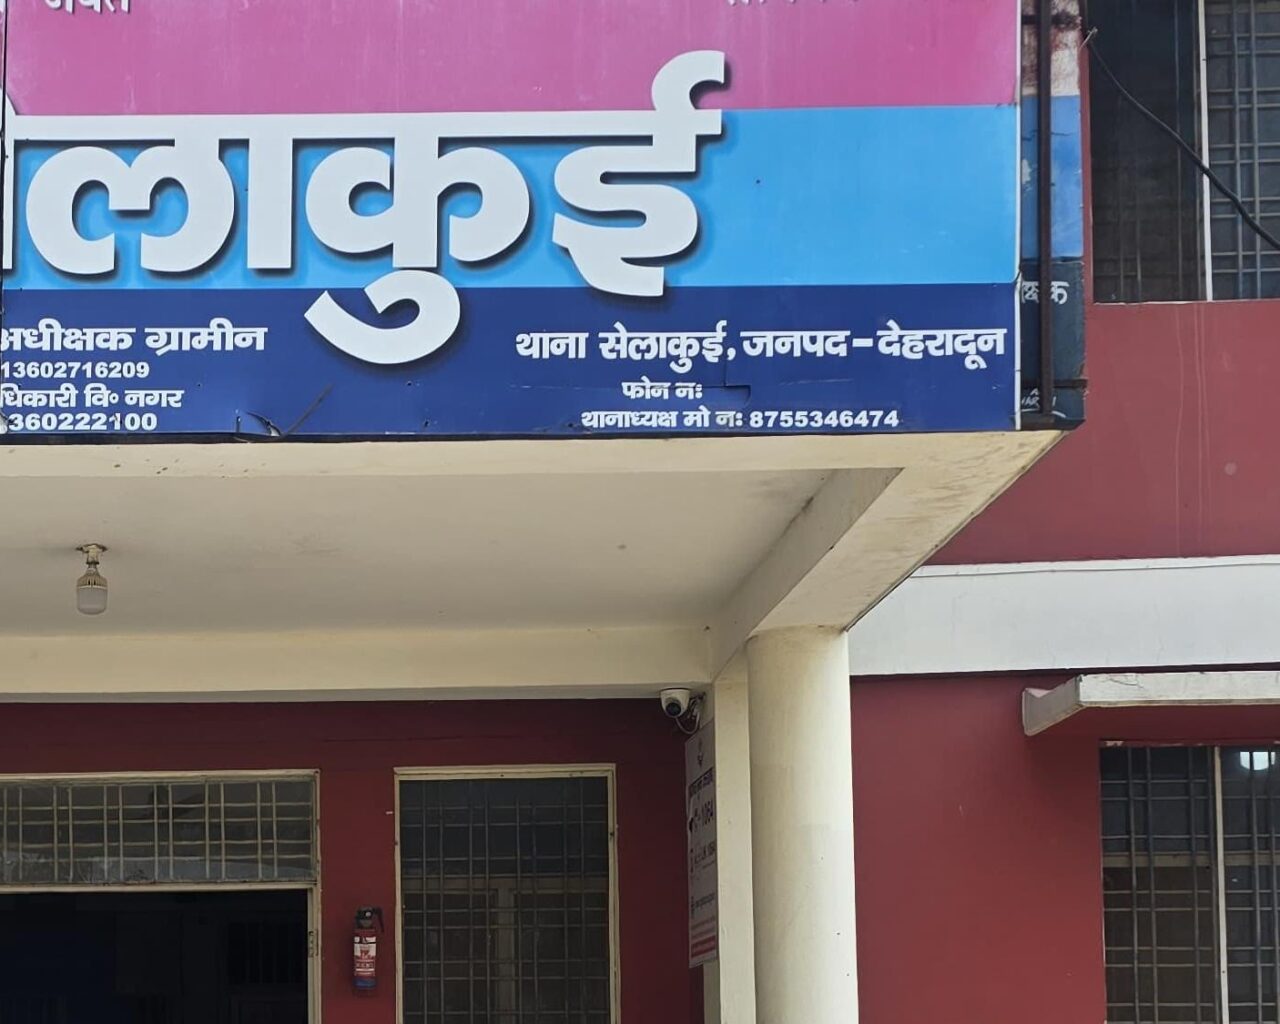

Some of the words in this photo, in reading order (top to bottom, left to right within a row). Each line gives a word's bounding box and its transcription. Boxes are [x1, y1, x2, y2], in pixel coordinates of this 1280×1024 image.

[144, 317, 268, 356] ग्रामीन
[516, 332, 589, 359] थाना
[124, 390, 185, 408] नगर
[622, 381, 670, 399] फोन
[581, 410, 679, 428] थानाध्यक्ष
[683, 405, 711, 427] मो
[749, 410, 900, 428] 8755346474
